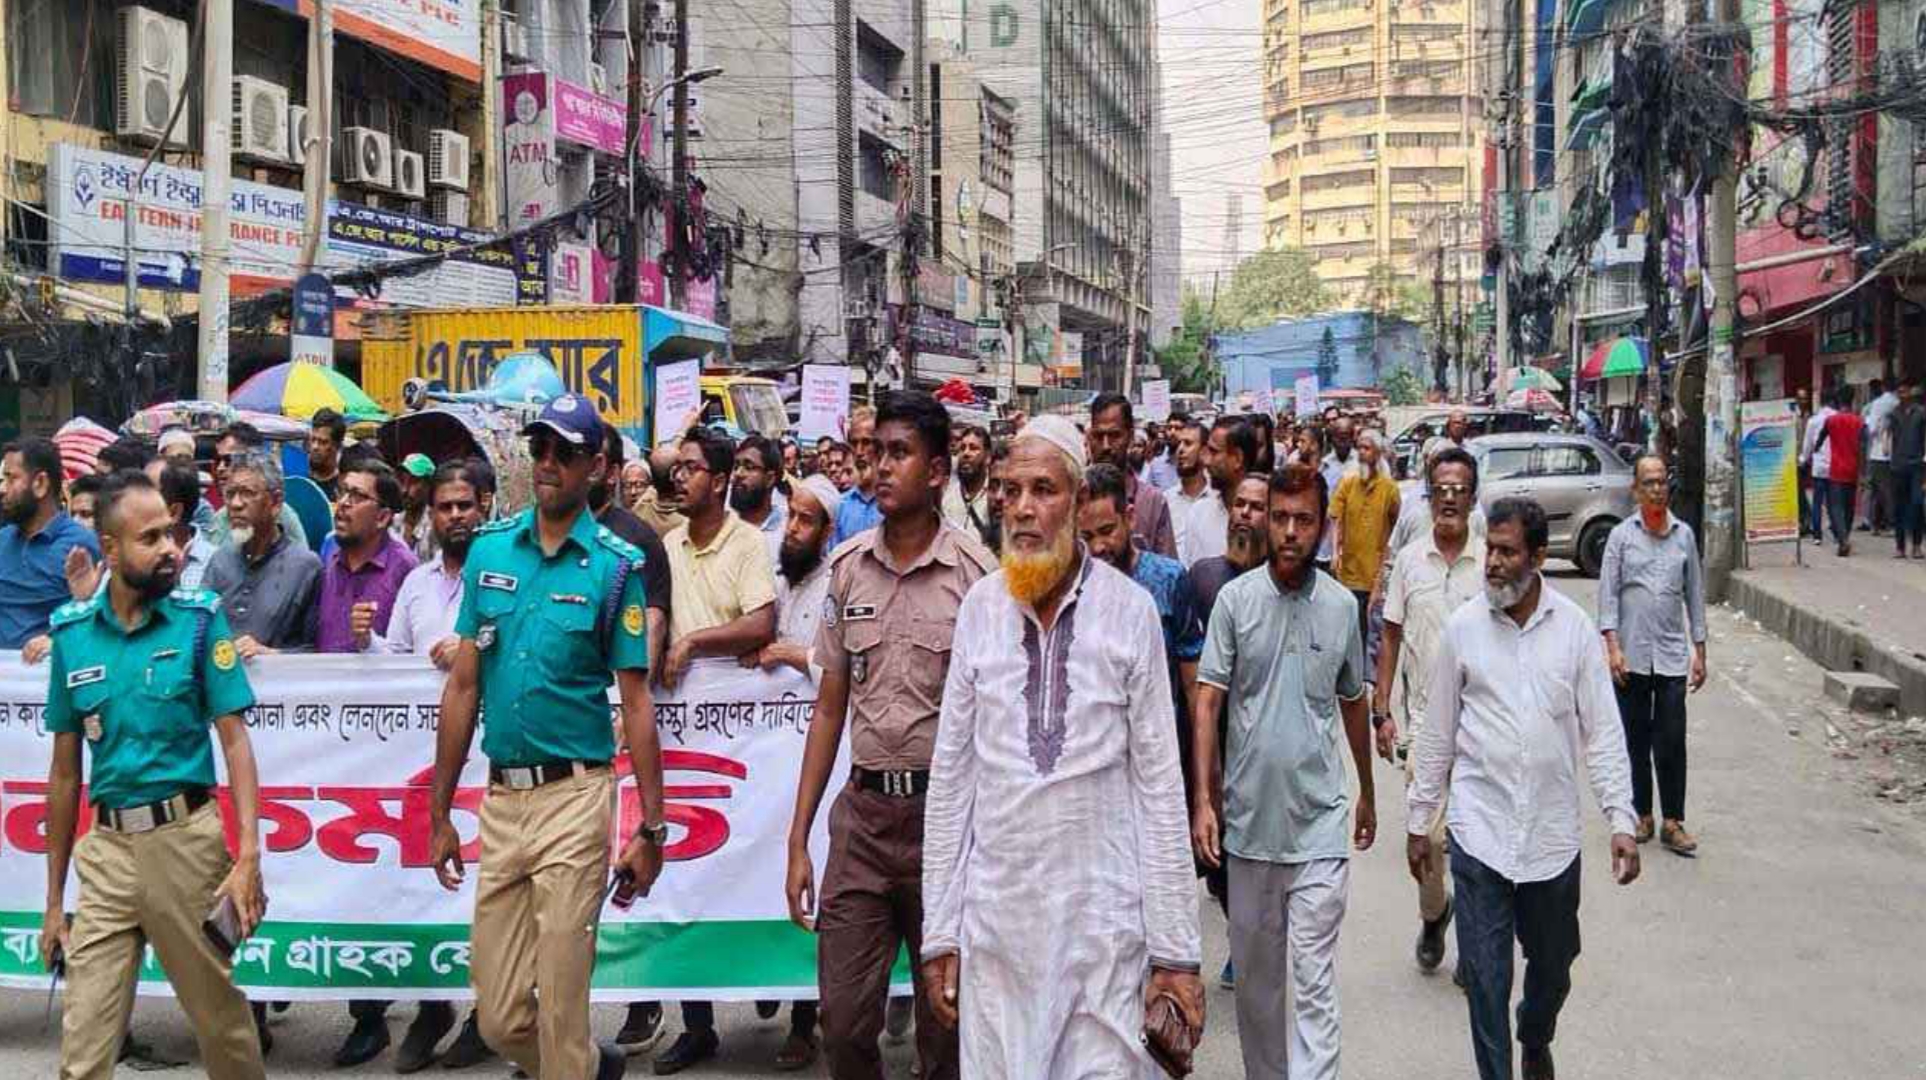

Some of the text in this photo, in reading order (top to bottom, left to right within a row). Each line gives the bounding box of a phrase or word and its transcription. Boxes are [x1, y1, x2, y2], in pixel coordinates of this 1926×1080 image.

[988, 4, 1019, 48] D
[509, 142, 547, 164] ATM
[100, 200, 303, 247] EATERN INRANCE PL
[292, 704, 330, 732] এবং
[339, 704, 409, 741] লেনদেন
[695, 700, 755, 739] গ্রহণের
[287, 935, 414, 979] গ্রাহক
